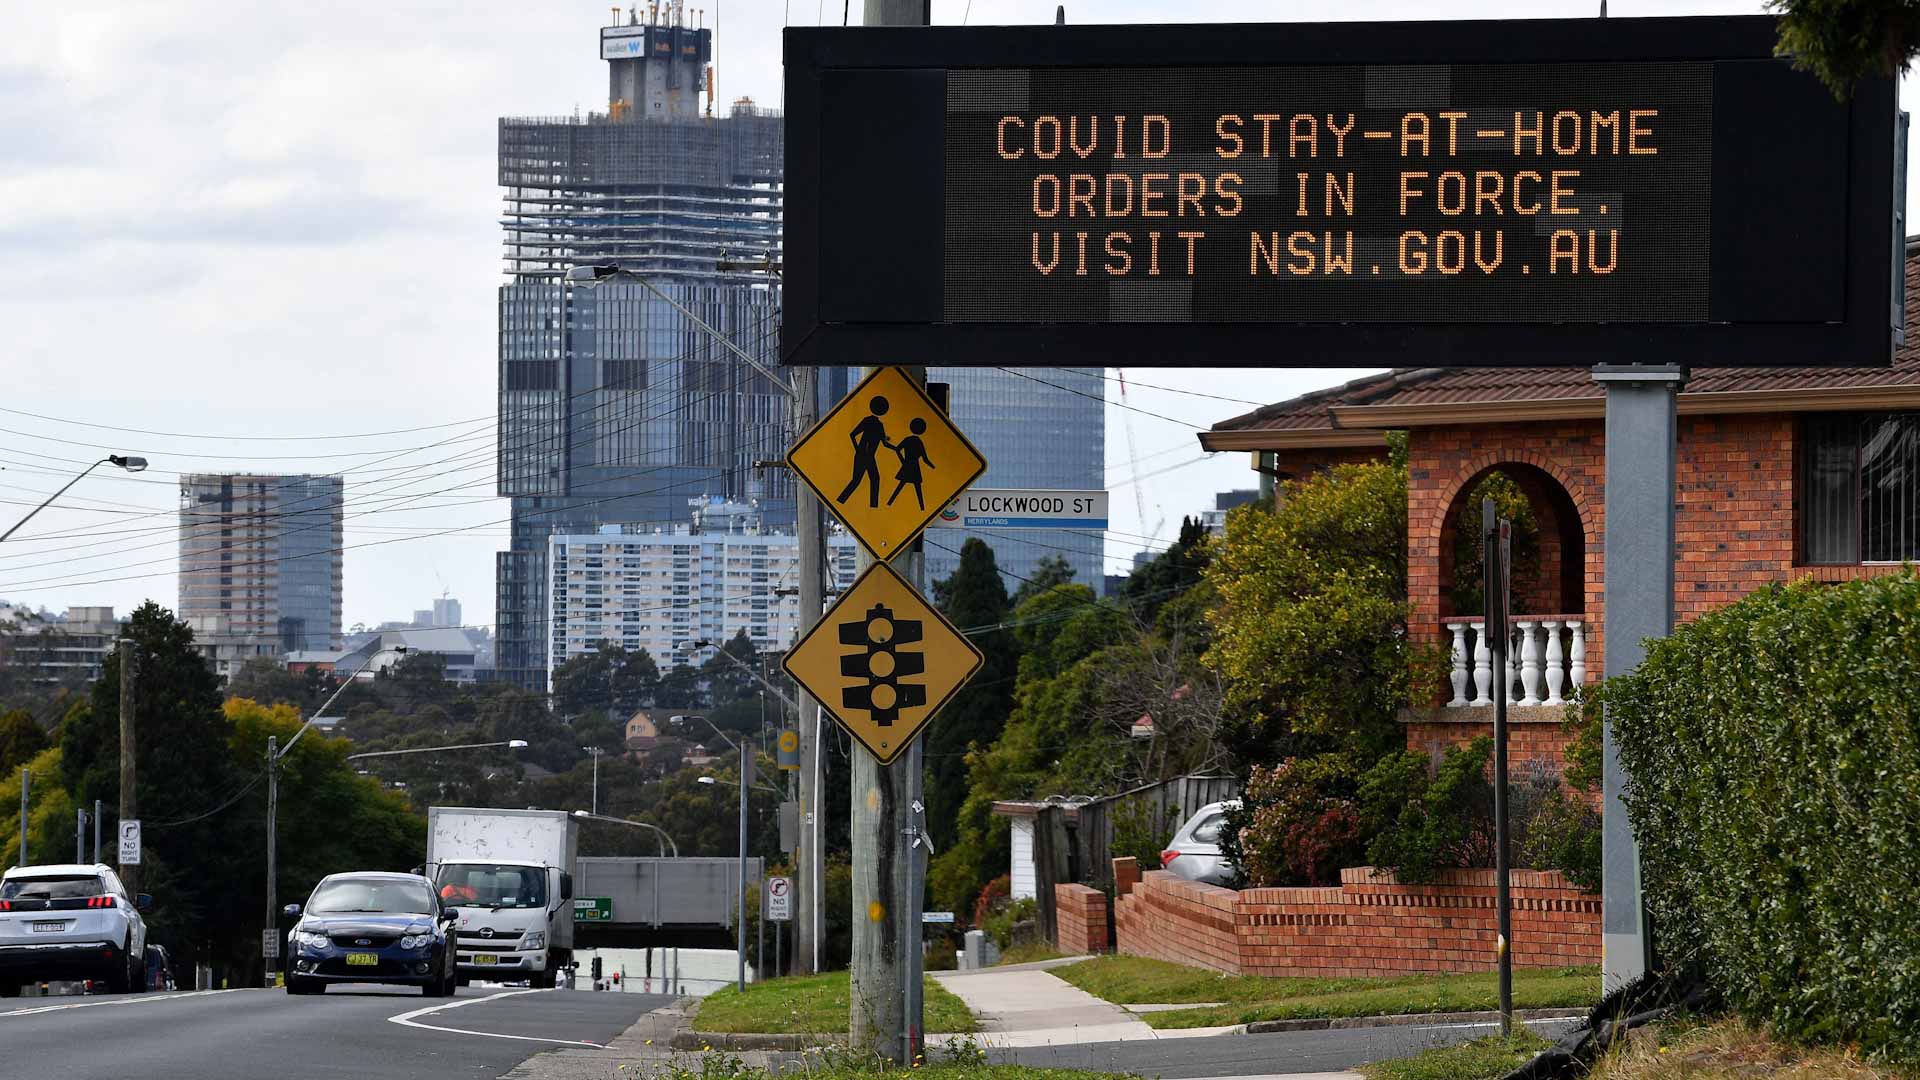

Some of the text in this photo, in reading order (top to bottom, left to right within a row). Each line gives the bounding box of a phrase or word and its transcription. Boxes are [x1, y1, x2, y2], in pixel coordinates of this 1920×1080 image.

[997, 109, 1659, 160] COVID STAY-AT-HOME
[1032, 170, 1608, 217] ORDERS IN FORCE.
[1032, 229, 1618, 275] VISIT NSW.GOV.AU
[967, 496, 1095, 514] LOCKWOOD ST
[967, 517, 1009, 526] MERRYLANDS
[124, 841, 136, 850] NO
